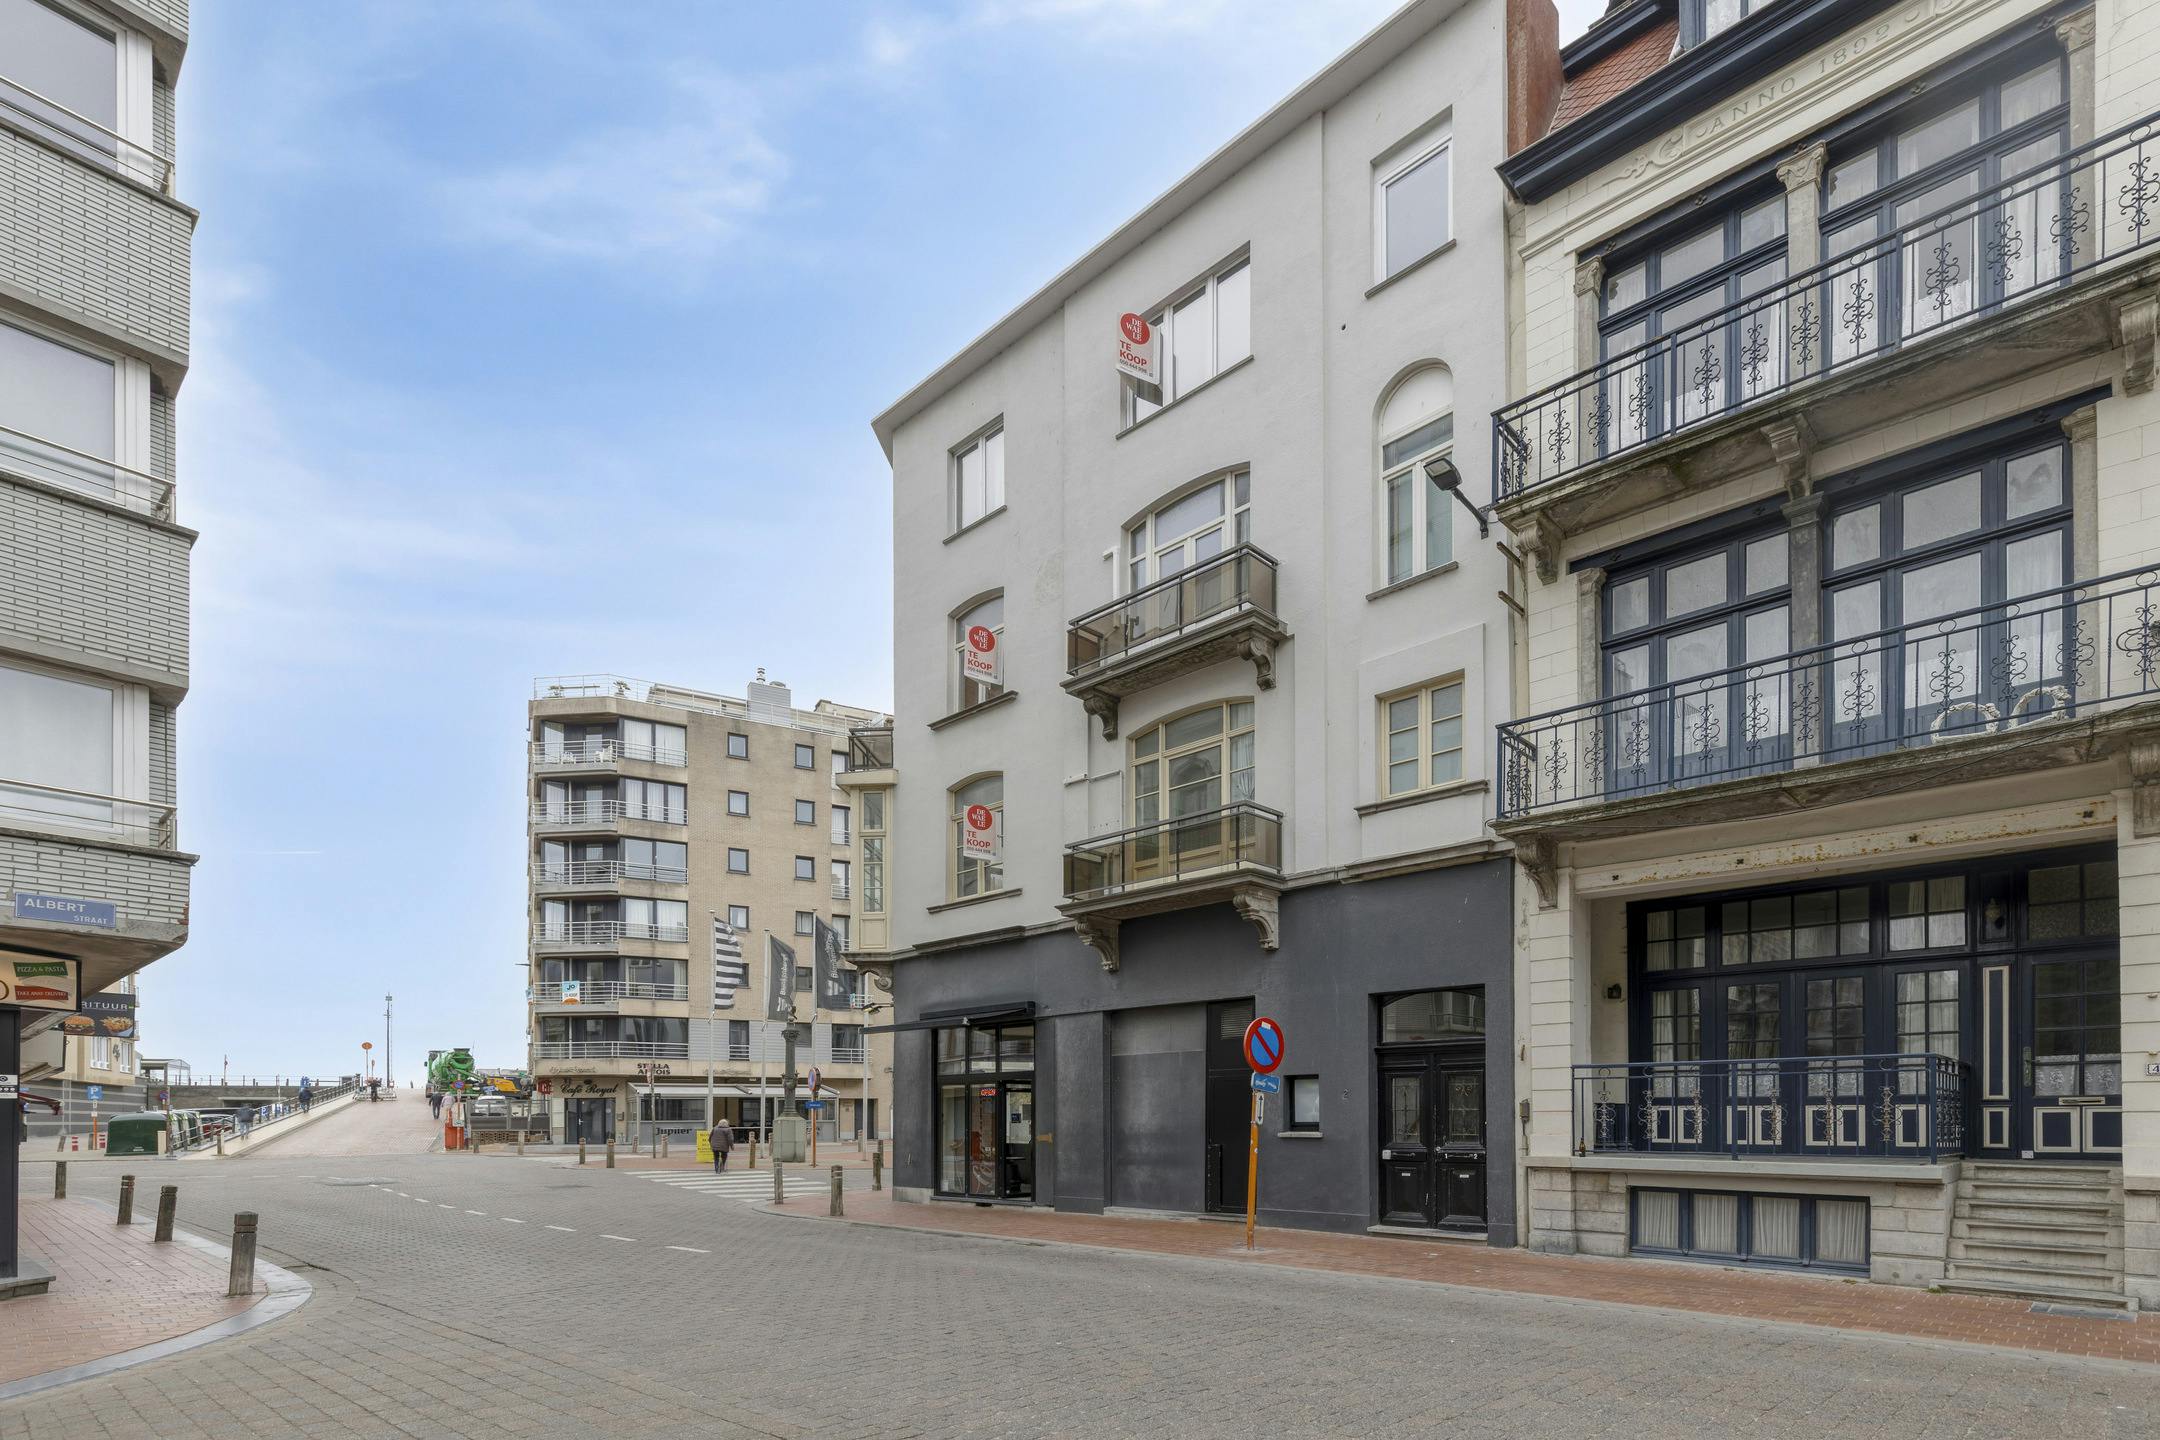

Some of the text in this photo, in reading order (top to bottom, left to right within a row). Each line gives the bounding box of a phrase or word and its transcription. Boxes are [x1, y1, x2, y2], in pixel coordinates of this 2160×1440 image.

[1710, 24, 1890, 133] ANNO 1892
[1120, 340, 1131, 352] TE
[1120, 350, 1147, 366] KOOP
[968, 650, 978, 659] TE
[968, 658, 992, 670] KOOP
[967, 830, 976, 838] TE
[967, 838, 990, 848] KOOP
[25, 898, 86, 912] ALBERT
[74, 915, 107, 925] STRAAT
[45, 966, 65, 974] PASTA
[585, 1083, 618, 1096] Royal
